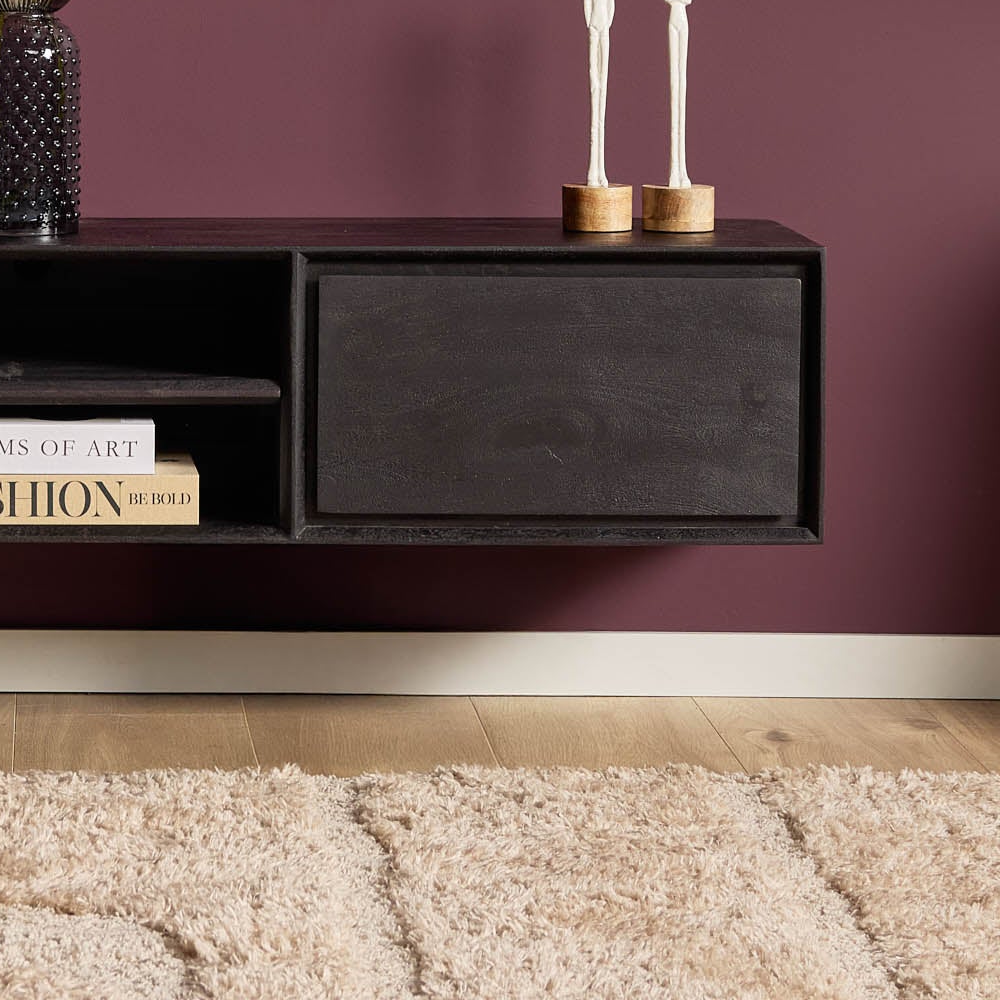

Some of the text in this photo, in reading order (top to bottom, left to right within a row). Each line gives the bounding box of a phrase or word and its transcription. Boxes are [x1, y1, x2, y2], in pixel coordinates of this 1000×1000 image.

[41, 439, 76, 457] OF
[87, 439, 138, 458] ART
[128, 493, 148, 505] BE
[151, 493, 191, 505] BOLD
